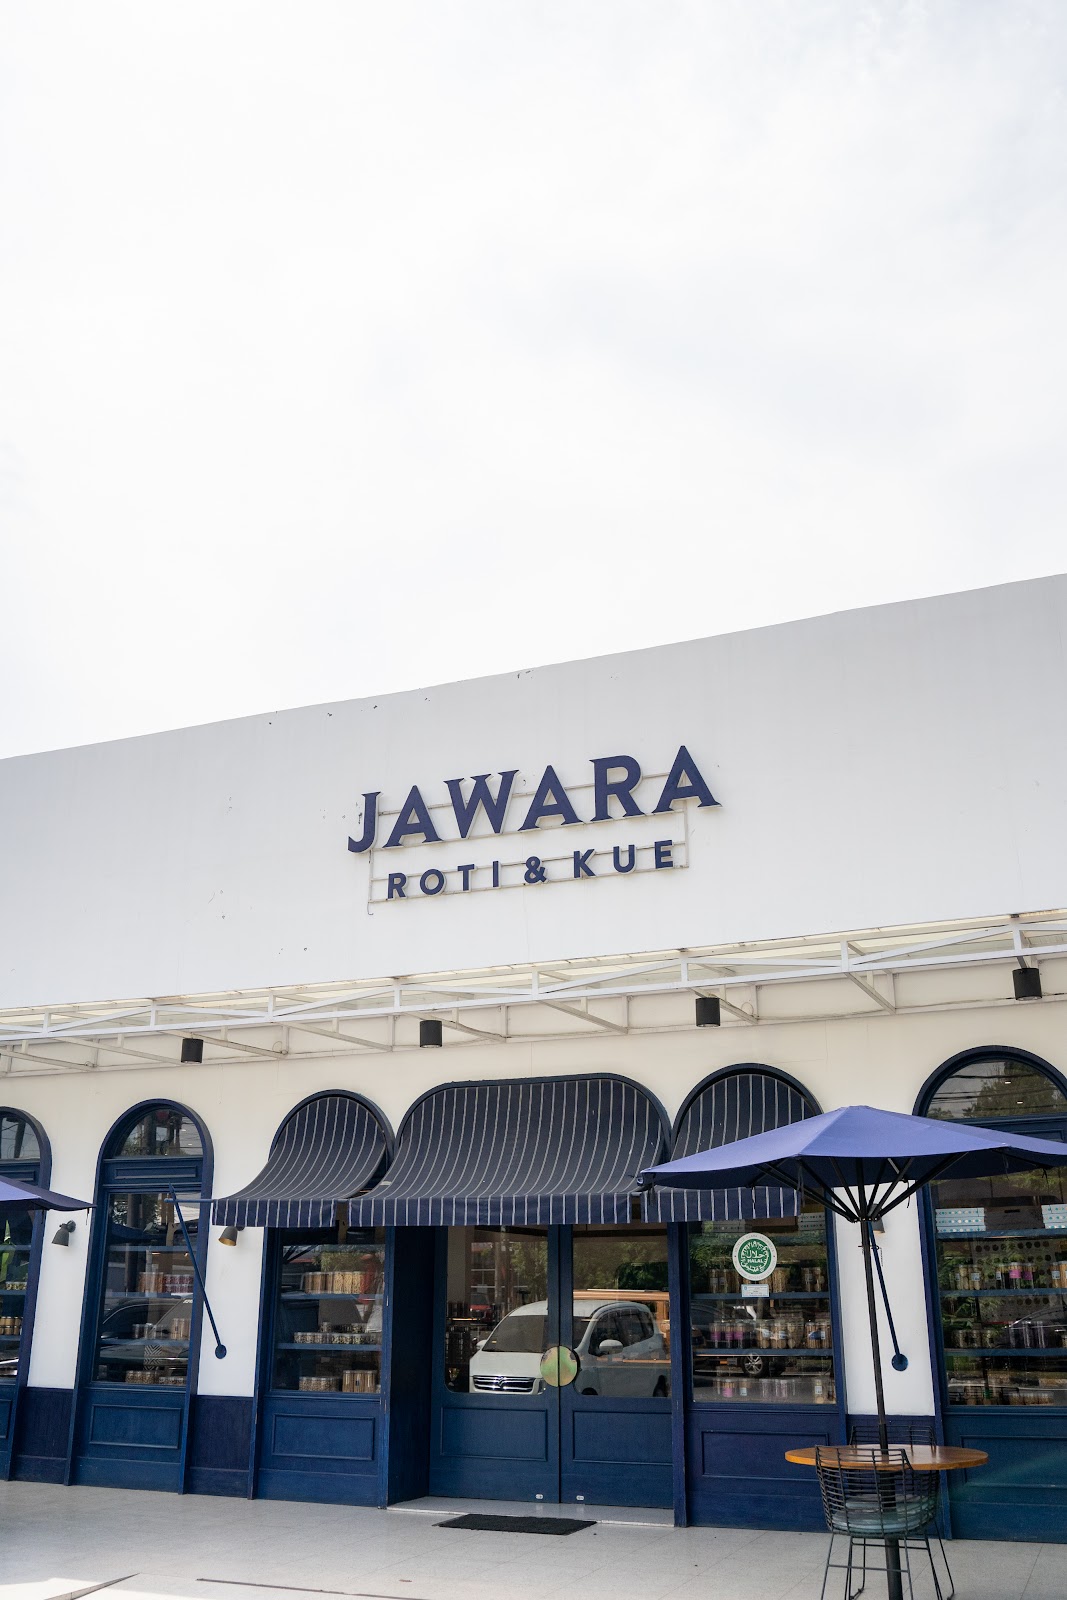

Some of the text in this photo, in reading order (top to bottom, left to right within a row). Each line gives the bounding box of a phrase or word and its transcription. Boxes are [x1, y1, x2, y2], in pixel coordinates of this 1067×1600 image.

[347, 745, 722, 853] JAWARA
[387, 839, 674, 900] ROTI & KUE
